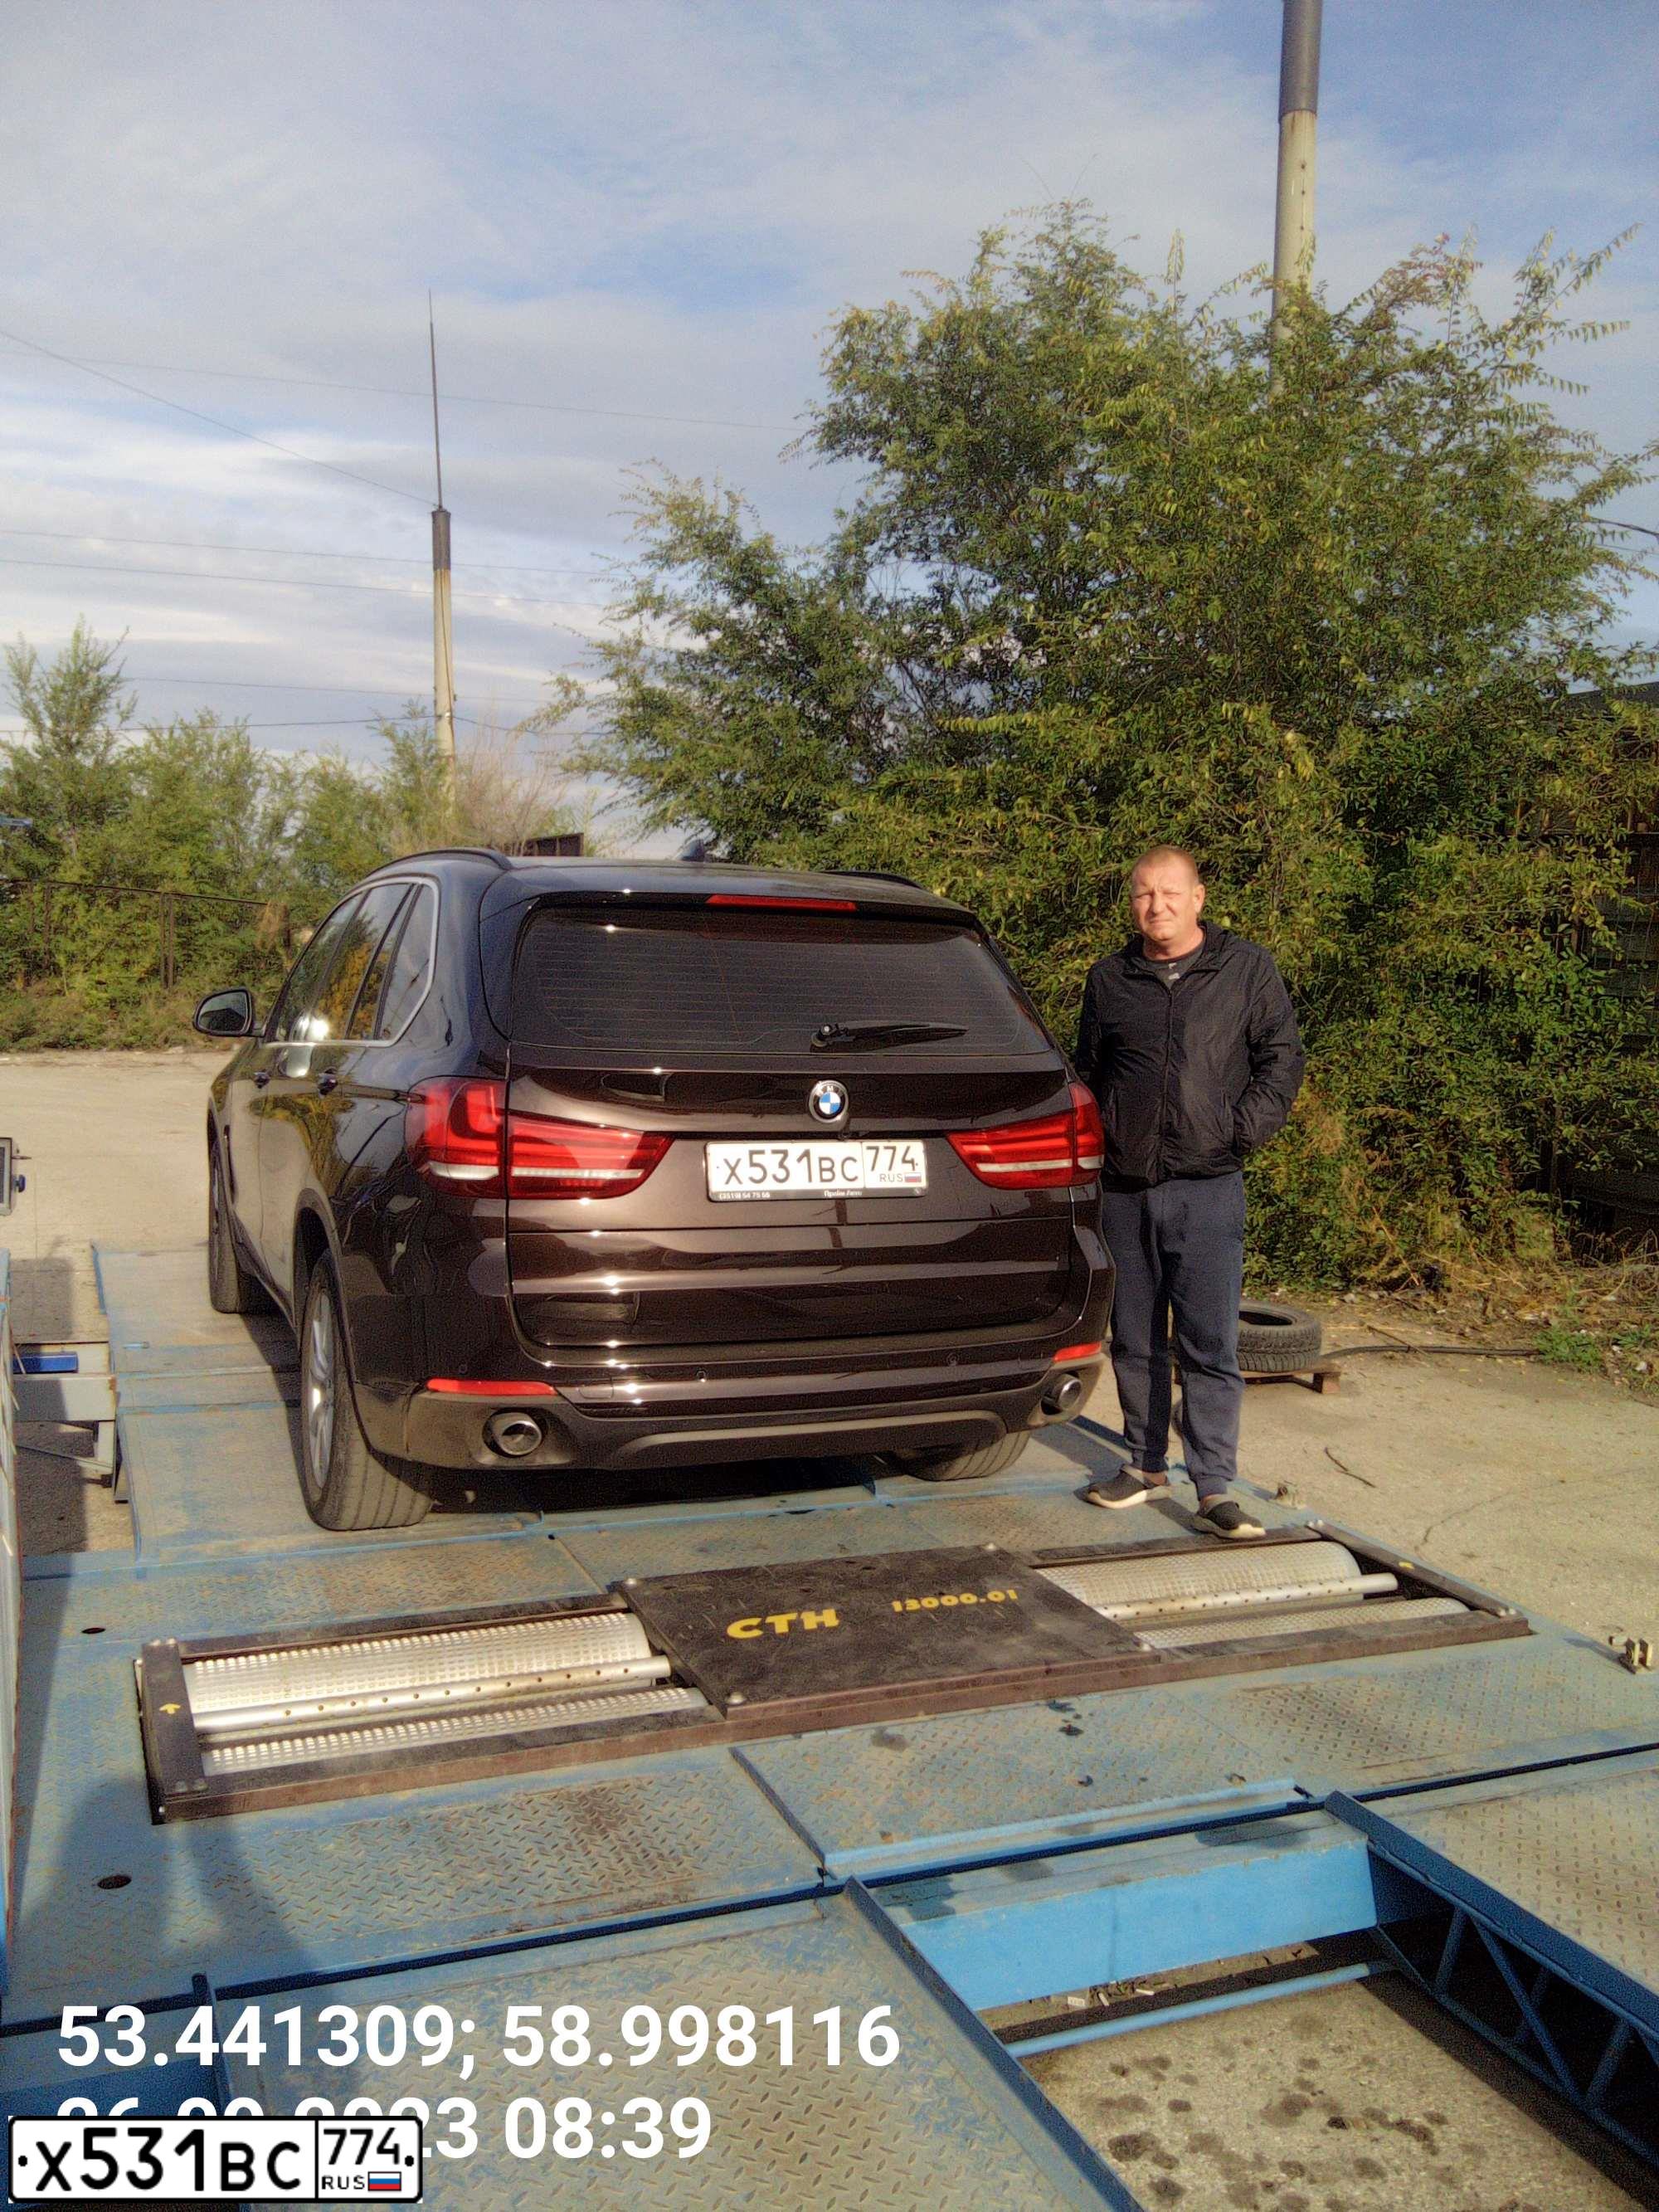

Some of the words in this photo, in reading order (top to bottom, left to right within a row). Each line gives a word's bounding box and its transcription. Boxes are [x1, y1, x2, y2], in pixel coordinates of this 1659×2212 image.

[723, 1148, 859, 1185] Х531ВС
[866, 1145, 916, 1172] 774
[879, 1173, 903, 1182] RUS
